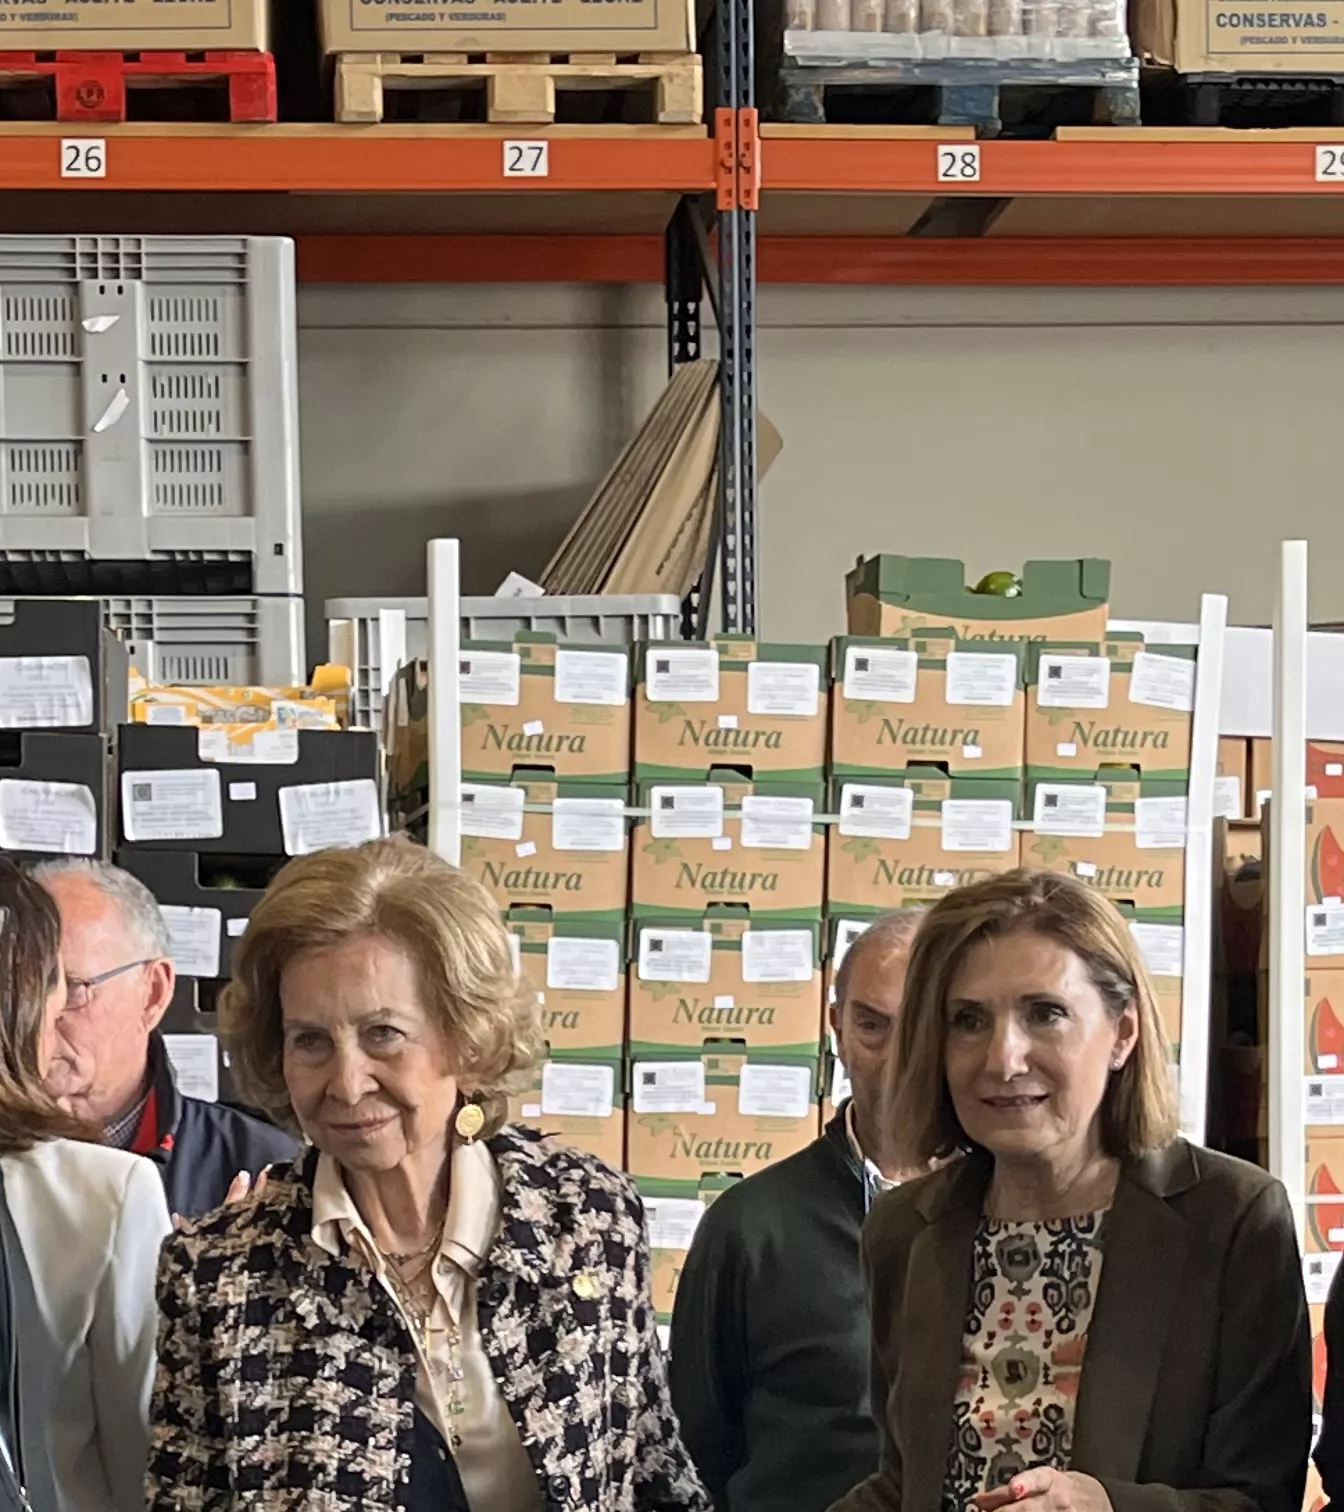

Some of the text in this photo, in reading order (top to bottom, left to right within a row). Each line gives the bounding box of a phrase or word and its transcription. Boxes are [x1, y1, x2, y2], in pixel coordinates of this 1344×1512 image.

[1216, 12, 1327, 28] CONSERVAS
[65, 145, 101, 172] 26
[508, 146, 544, 172] 27
[942, 152, 977, 178] 28
[481, 723, 586, 753] Natura
[678, 719, 782, 750] Natura
[876, 718, 980, 747] Natura
[1070, 721, 1169, 750] Natura
[480, 861, 583, 891] Natura
[675, 862, 778, 892] Natura
[672, 997, 775, 1025] Natura
[669, 1132, 773, 1160] Natura
